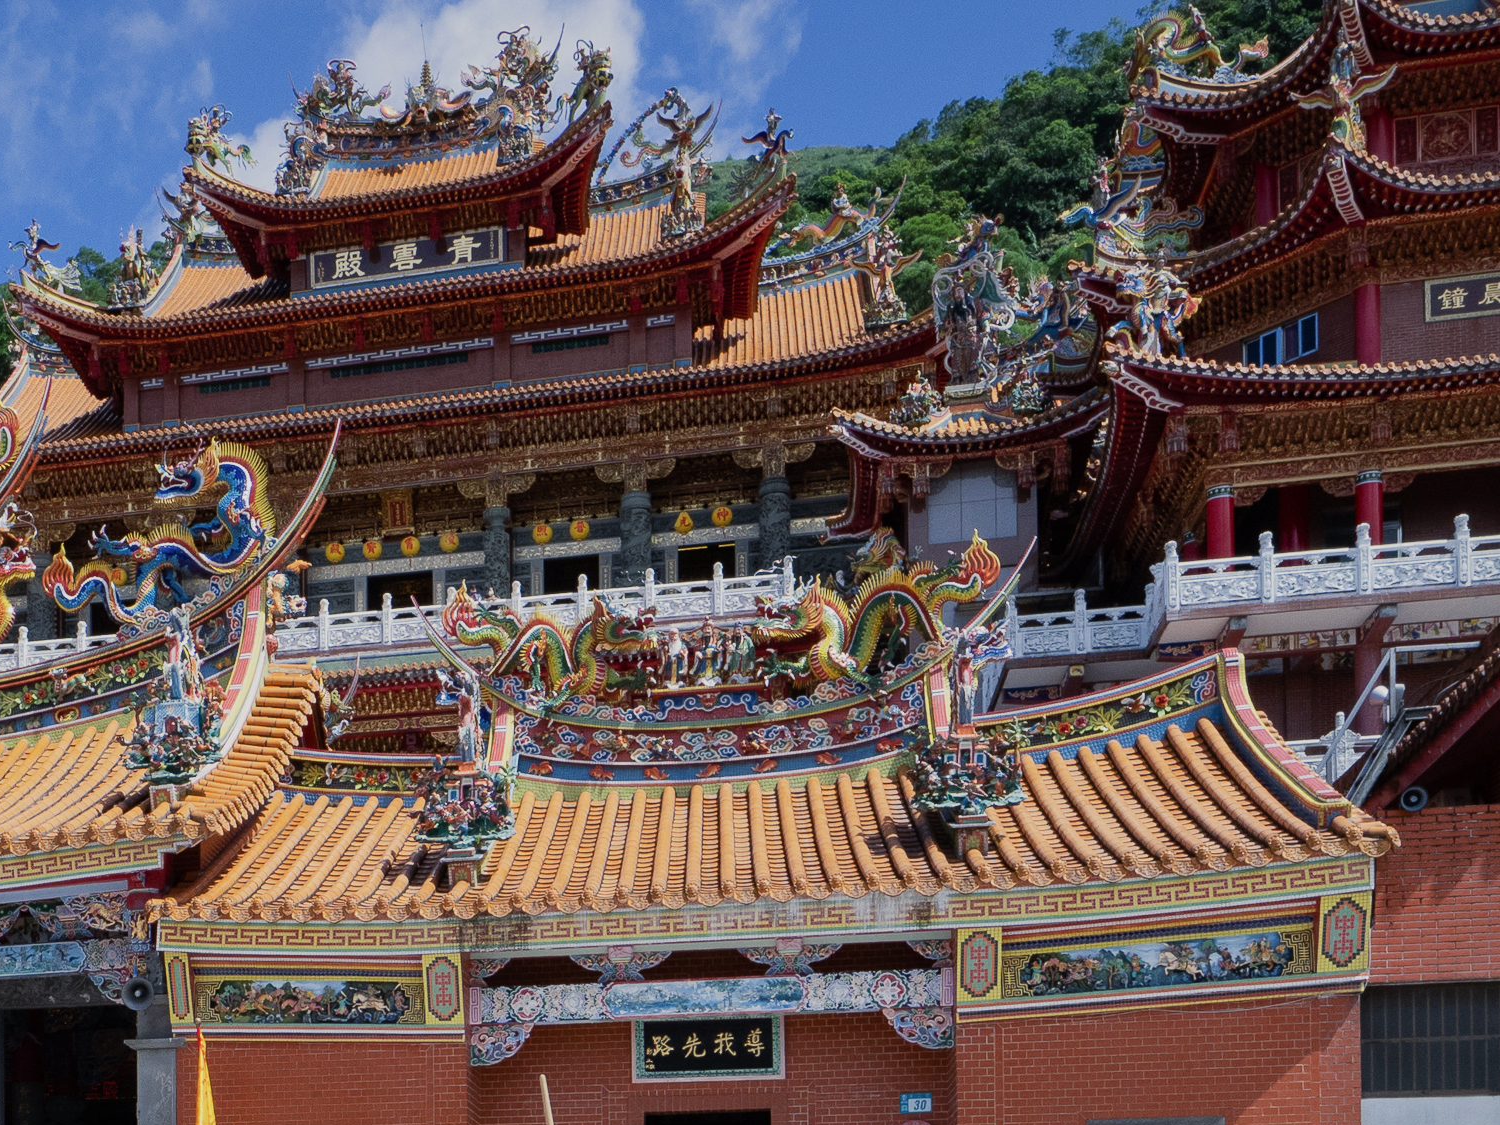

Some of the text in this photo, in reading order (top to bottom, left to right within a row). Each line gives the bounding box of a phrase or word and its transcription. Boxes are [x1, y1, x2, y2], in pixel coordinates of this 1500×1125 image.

[332, 235, 482, 279] 青雲殿
[1437, 282, 1500, 310] 晨鐘
[652, 1028, 766, 1059] 導我先路
[914, 1100, 927, 1110] 30
